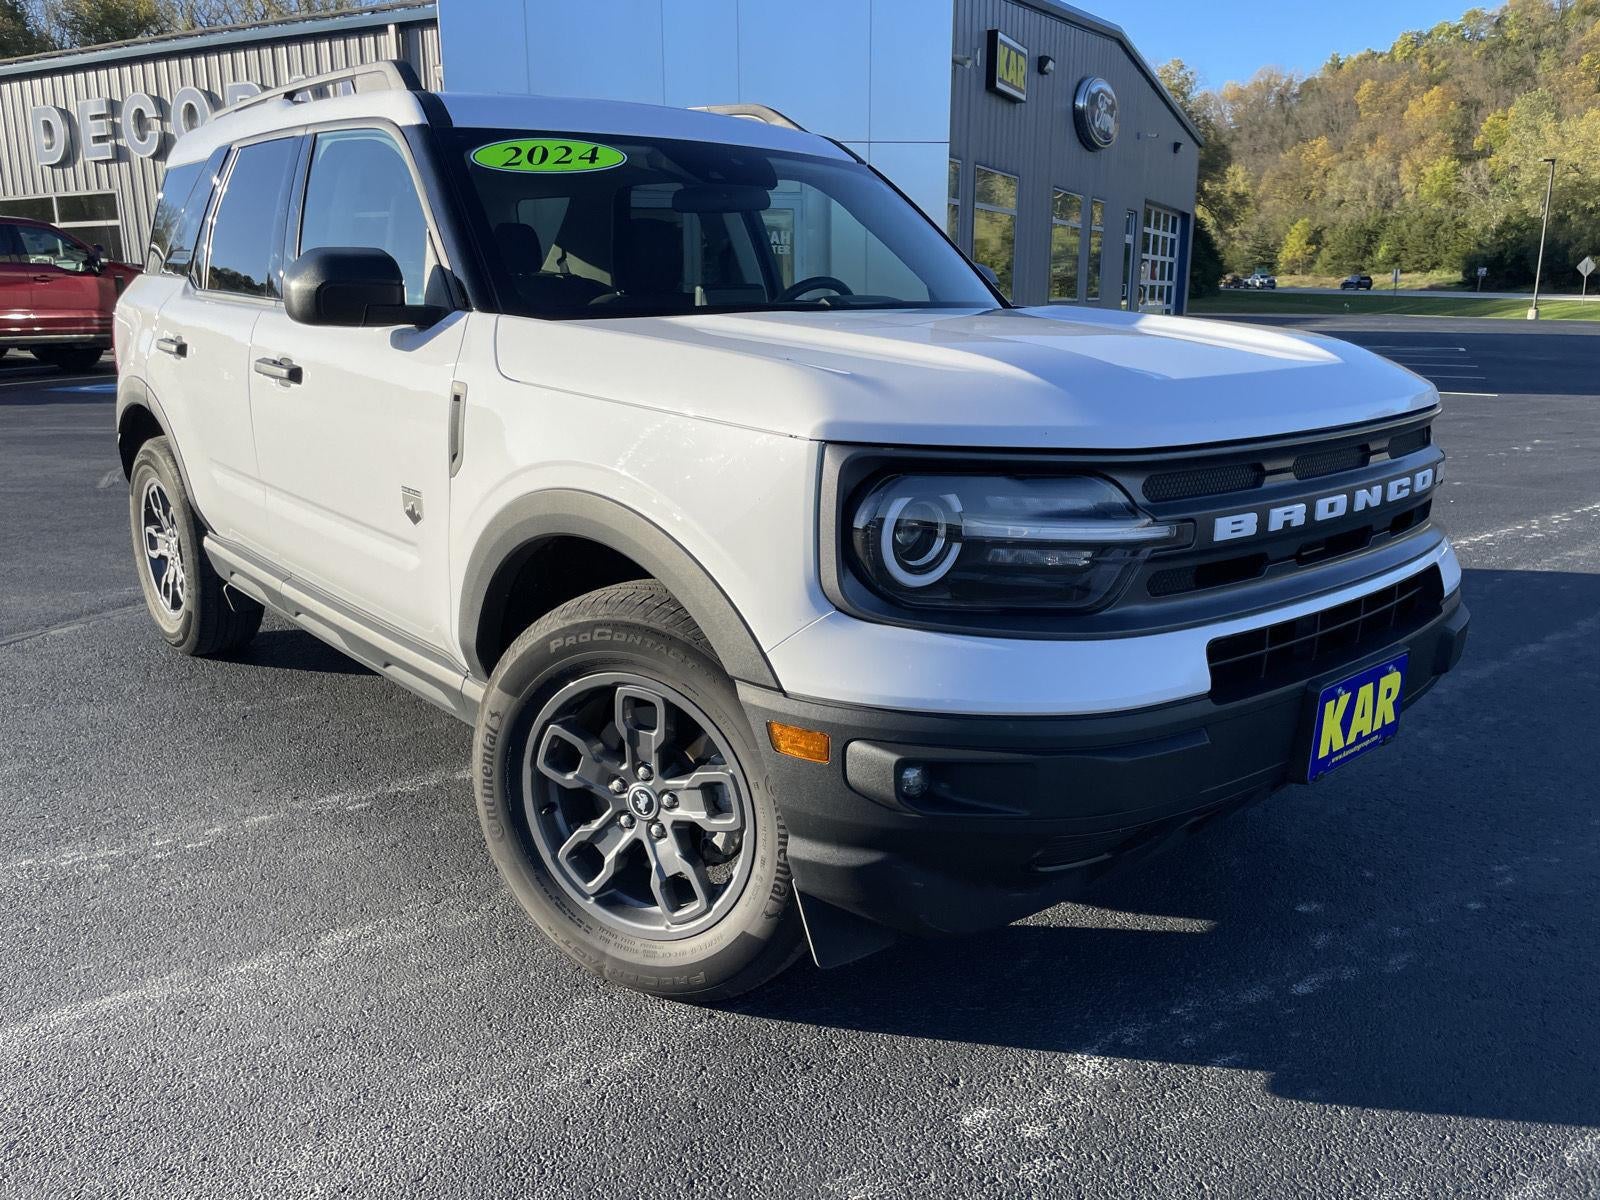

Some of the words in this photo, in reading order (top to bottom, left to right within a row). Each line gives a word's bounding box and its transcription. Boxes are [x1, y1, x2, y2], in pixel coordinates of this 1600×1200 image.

[998, 43, 1027, 91] KAR
[32, 75, 357, 167] DECO
[500, 144, 601, 168] 2024
[1212, 467, 1434, 543] BRONCO
[1317, 670, 1402, 760] KAR
